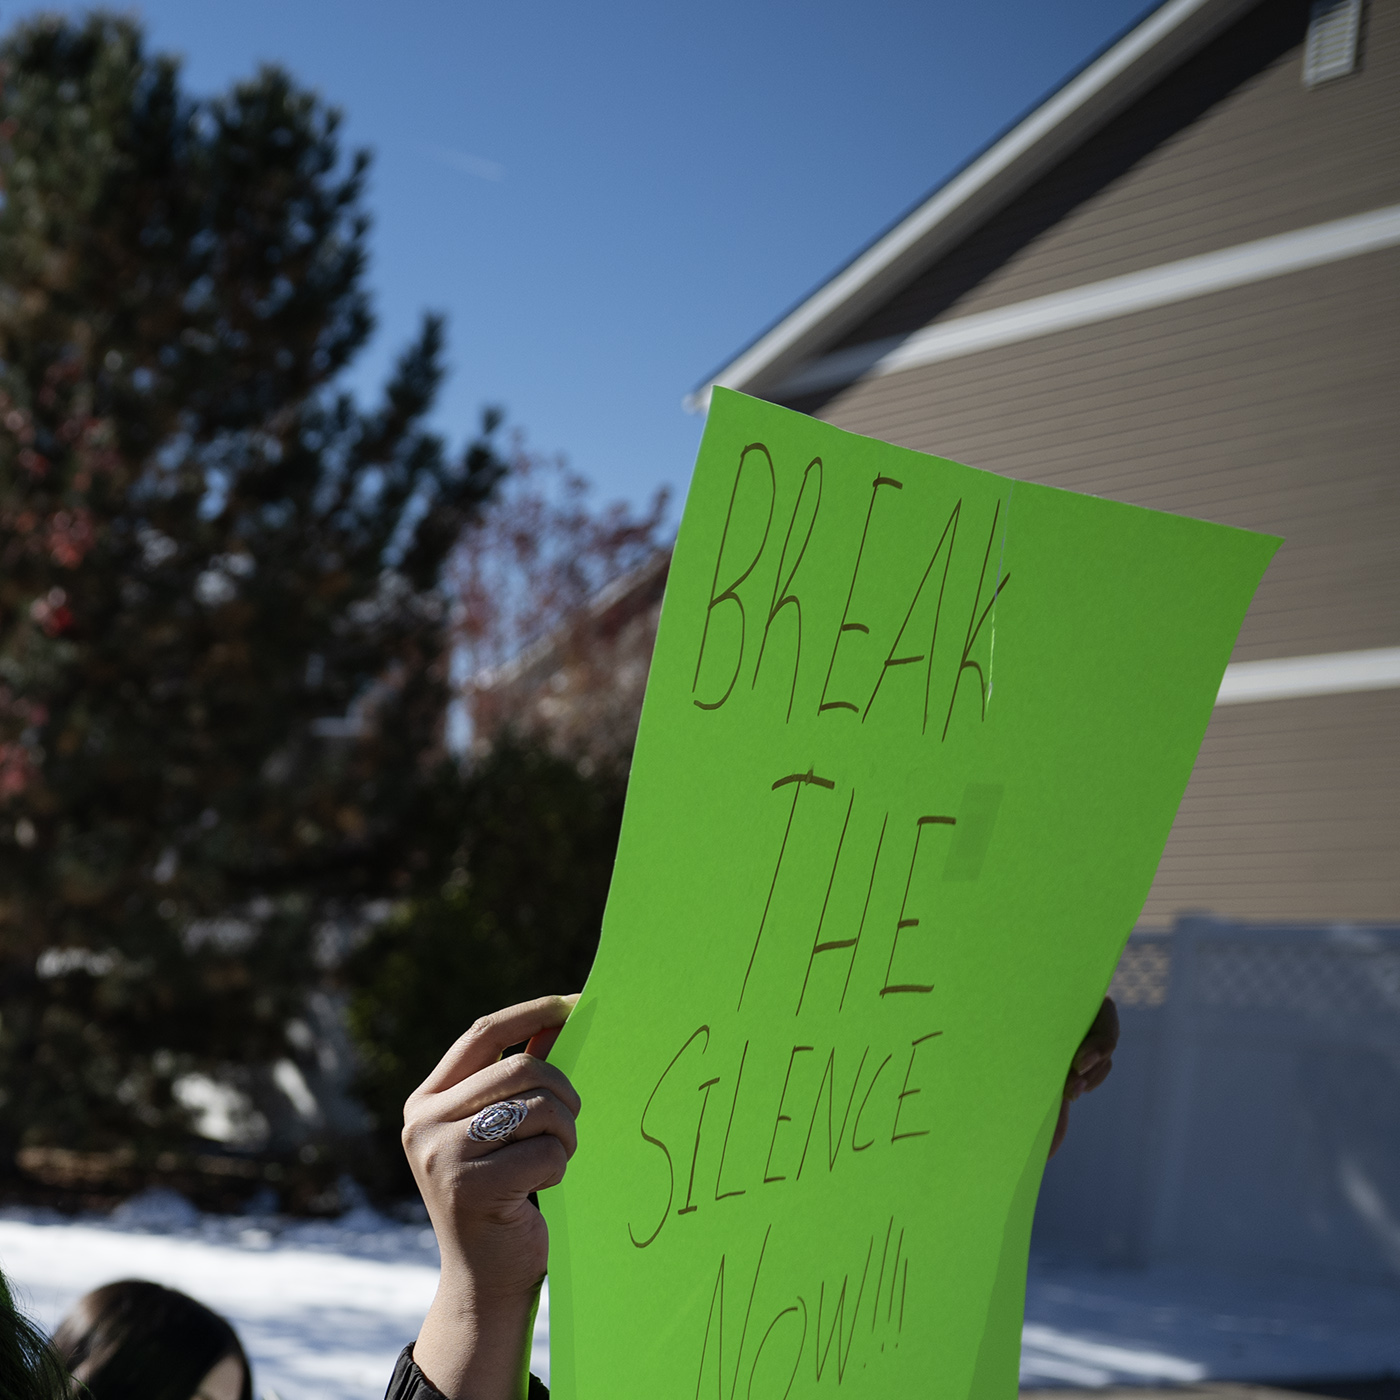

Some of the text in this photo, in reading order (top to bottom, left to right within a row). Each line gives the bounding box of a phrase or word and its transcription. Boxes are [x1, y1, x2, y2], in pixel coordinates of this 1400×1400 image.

[692, 442, 1011, 743] BREAK
[737, 769, 957, 1017] THE
[627, 1024, 944, 1249] SILENCE
